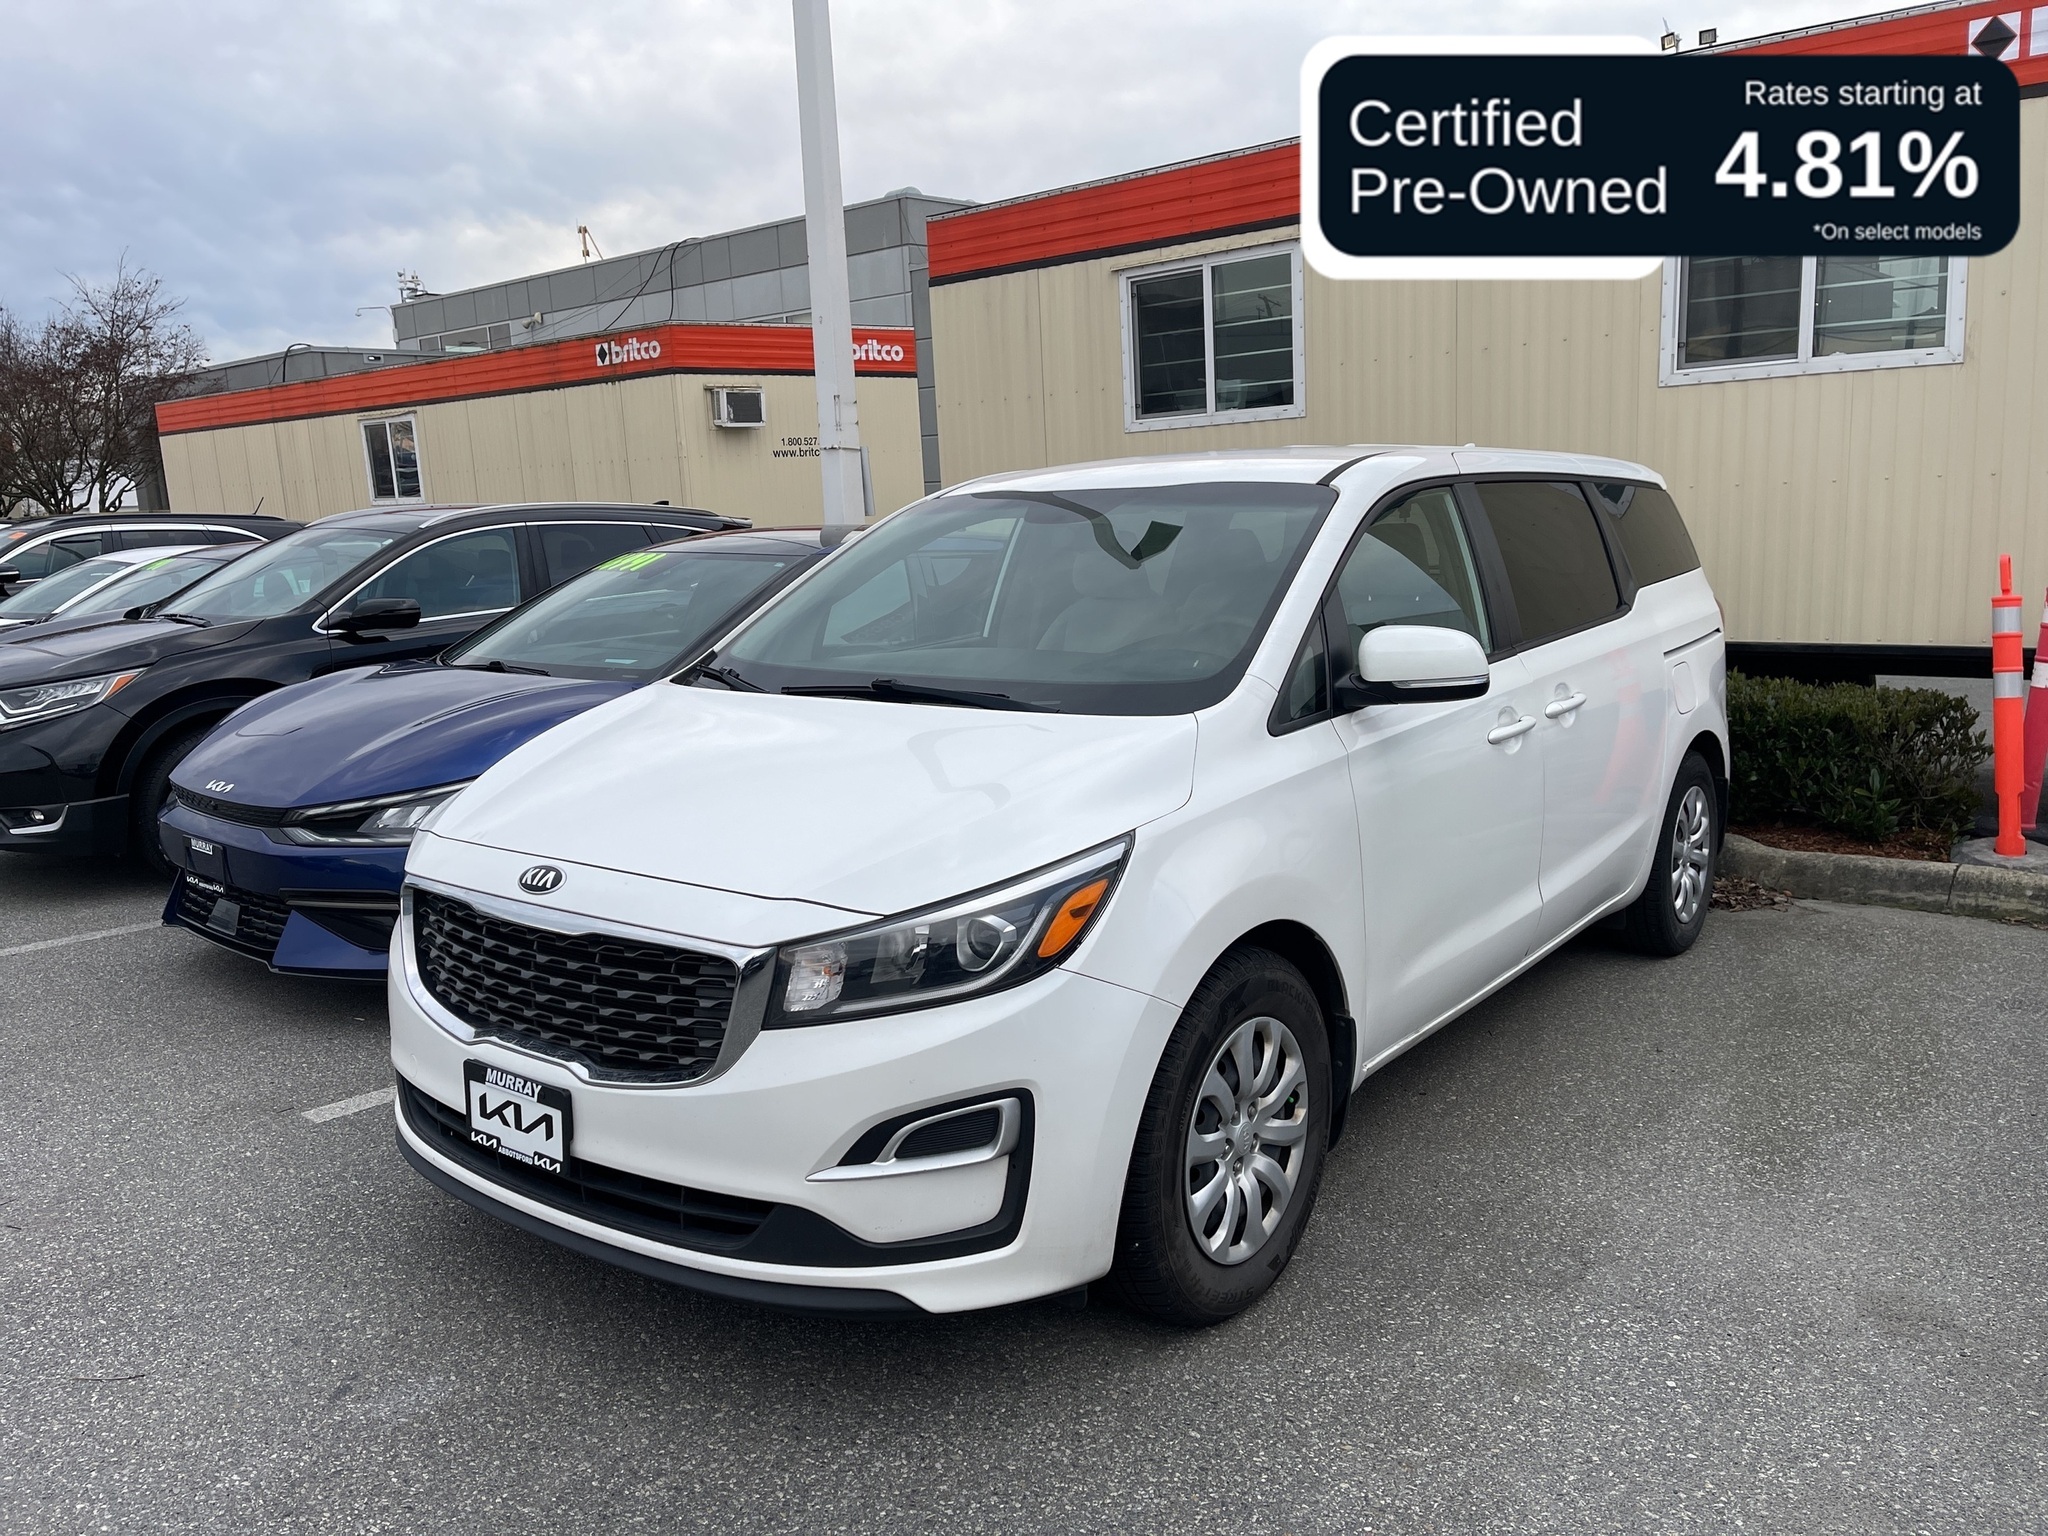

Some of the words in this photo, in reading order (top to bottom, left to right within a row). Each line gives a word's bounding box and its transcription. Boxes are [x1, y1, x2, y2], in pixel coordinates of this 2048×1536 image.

[610, 337, 661, 365] britco
[521, 867, 557, 889] KIA
[485, 1067, 542, 1099] MURRAY
[478, 1091, 554, 1142] KIA
[470, 1131, 498, 1149] KIA
[534, 1154, 561, 1174] KIA
